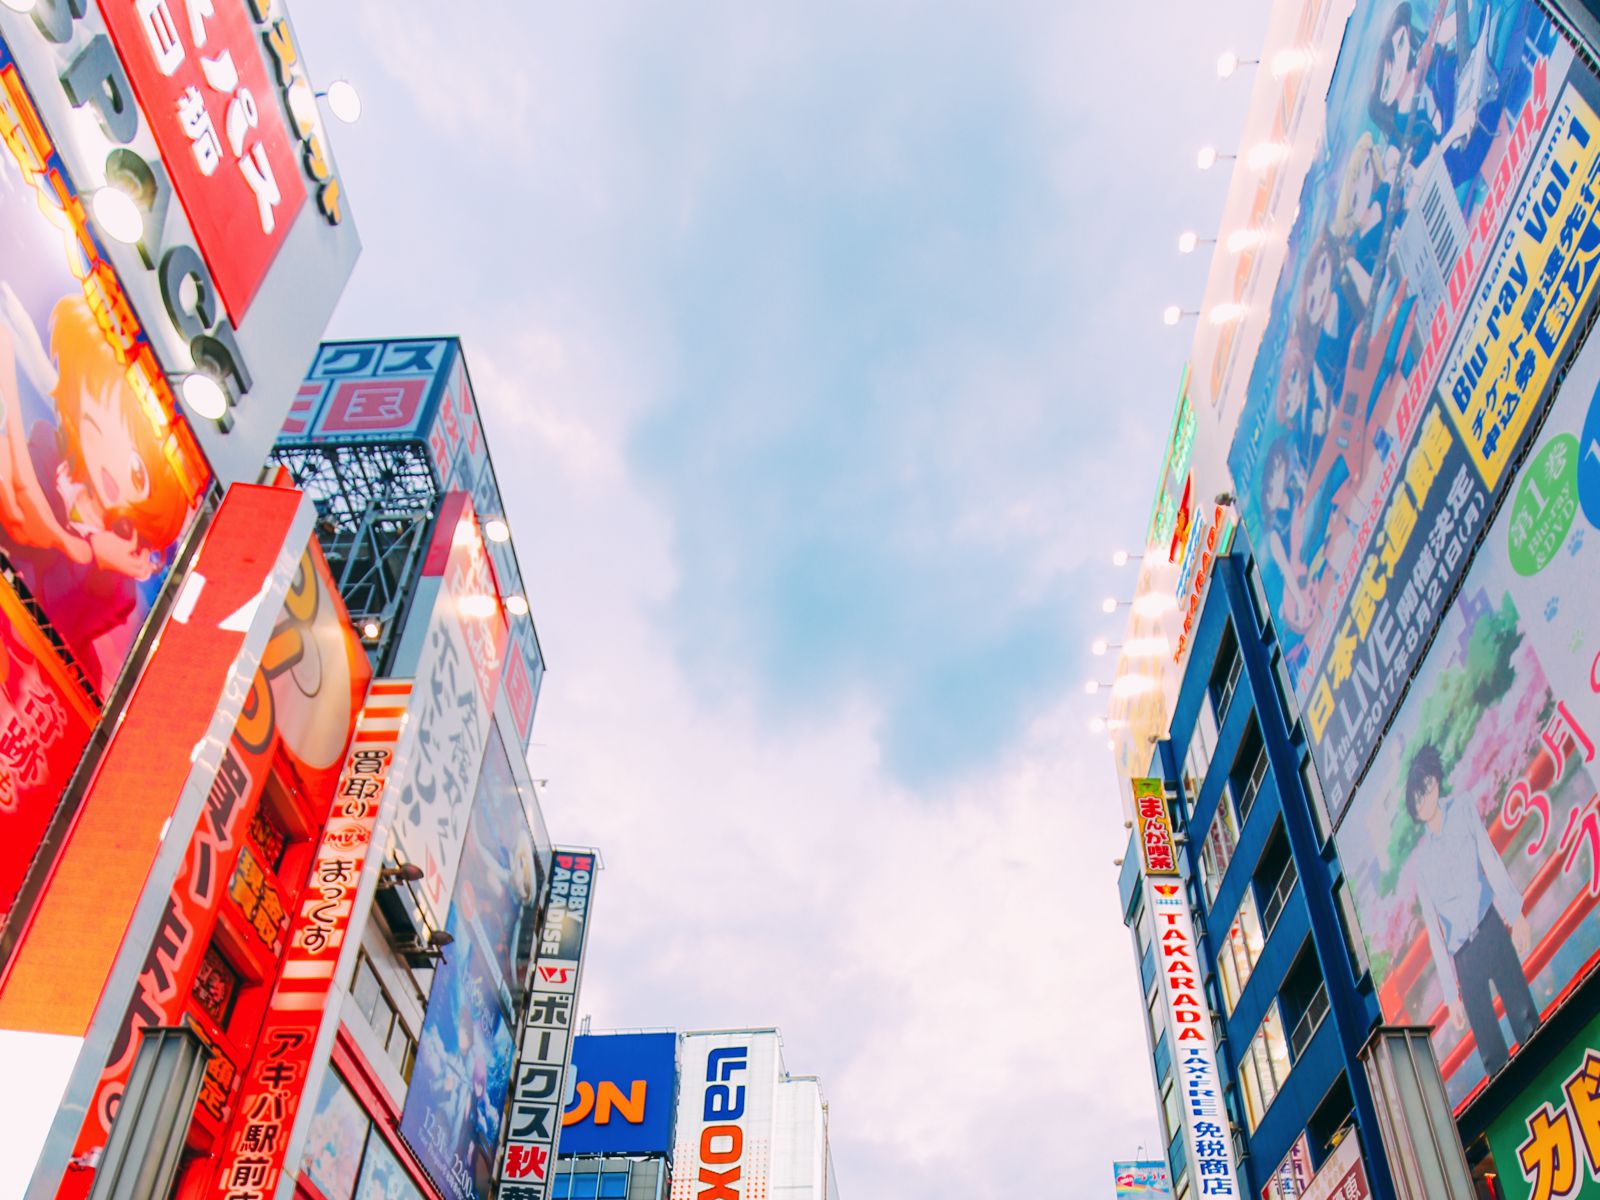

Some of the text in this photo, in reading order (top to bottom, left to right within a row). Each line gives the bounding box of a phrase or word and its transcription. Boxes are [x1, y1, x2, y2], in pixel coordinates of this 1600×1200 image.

[1450, 251, 1528, 416] Blu-ray
[1306, 404, 1454, 746] 日本武道館
[343, 749, 389, 818] 買取り
[1138, 796, 1174, 871] まんが喫茶
[541, 855, 574, 956] PARADISE
[569, 856, 593, 924] HOBBY
[1158, 912, 1207, 1042] TAKARADA
[1193, 1120, 1233, 1197] 免税商店
